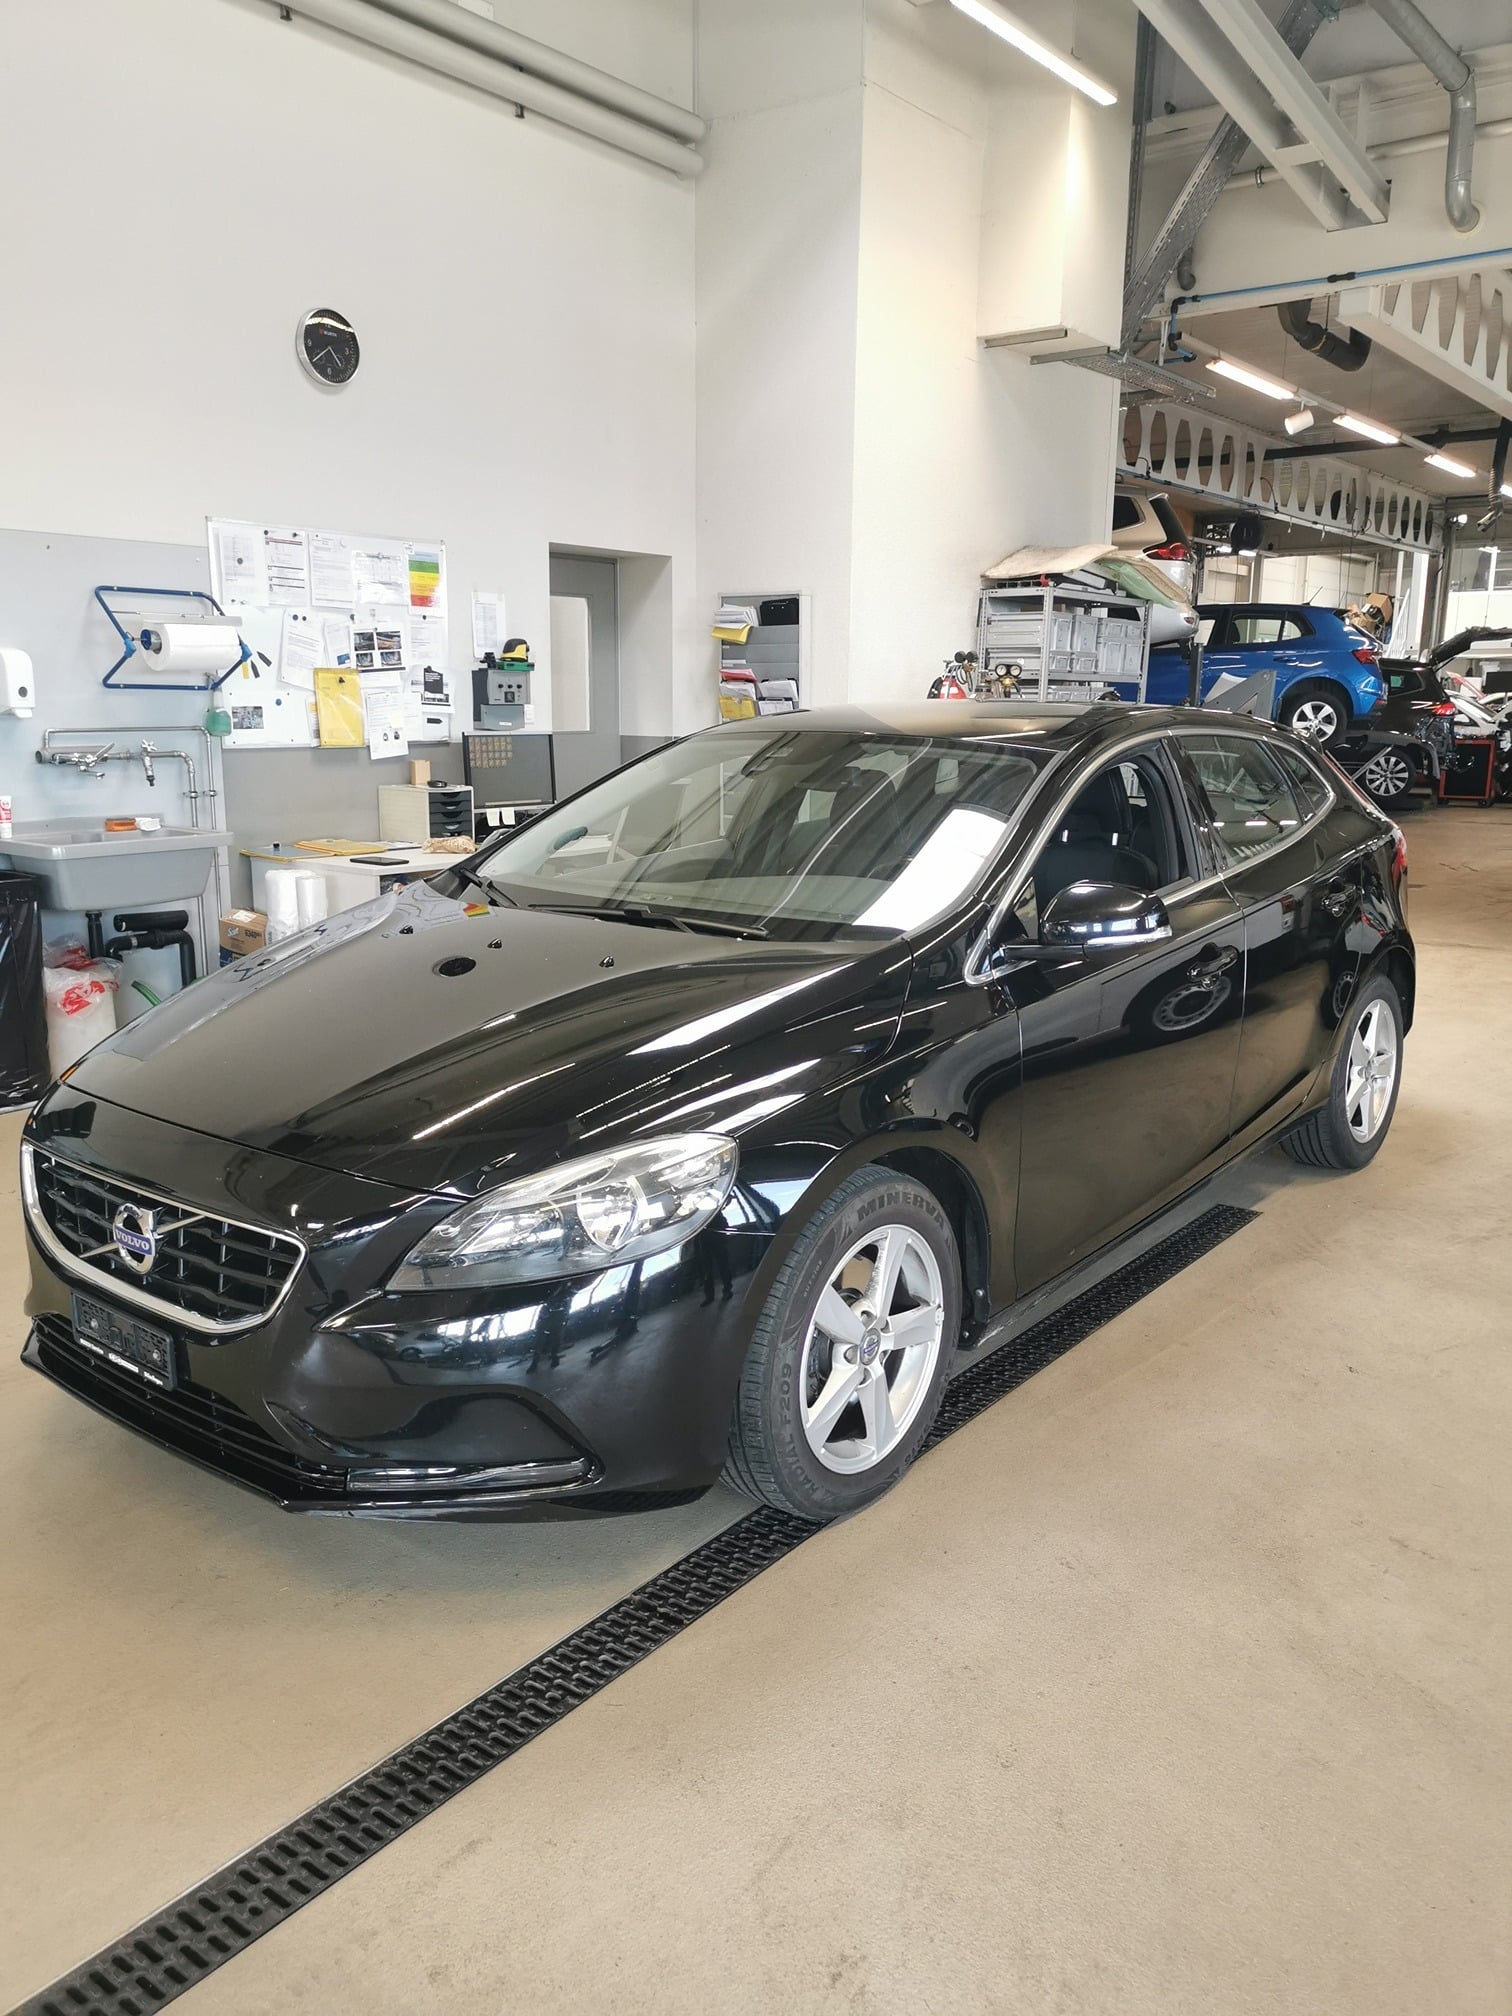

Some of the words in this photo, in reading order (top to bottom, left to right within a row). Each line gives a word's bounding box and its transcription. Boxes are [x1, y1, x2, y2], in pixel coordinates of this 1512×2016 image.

[857, 1190, 945, 1231] MINERVA
[115, 1228, 150, 1251] VOLVO
[778, 1362, 792, 1427] F209
